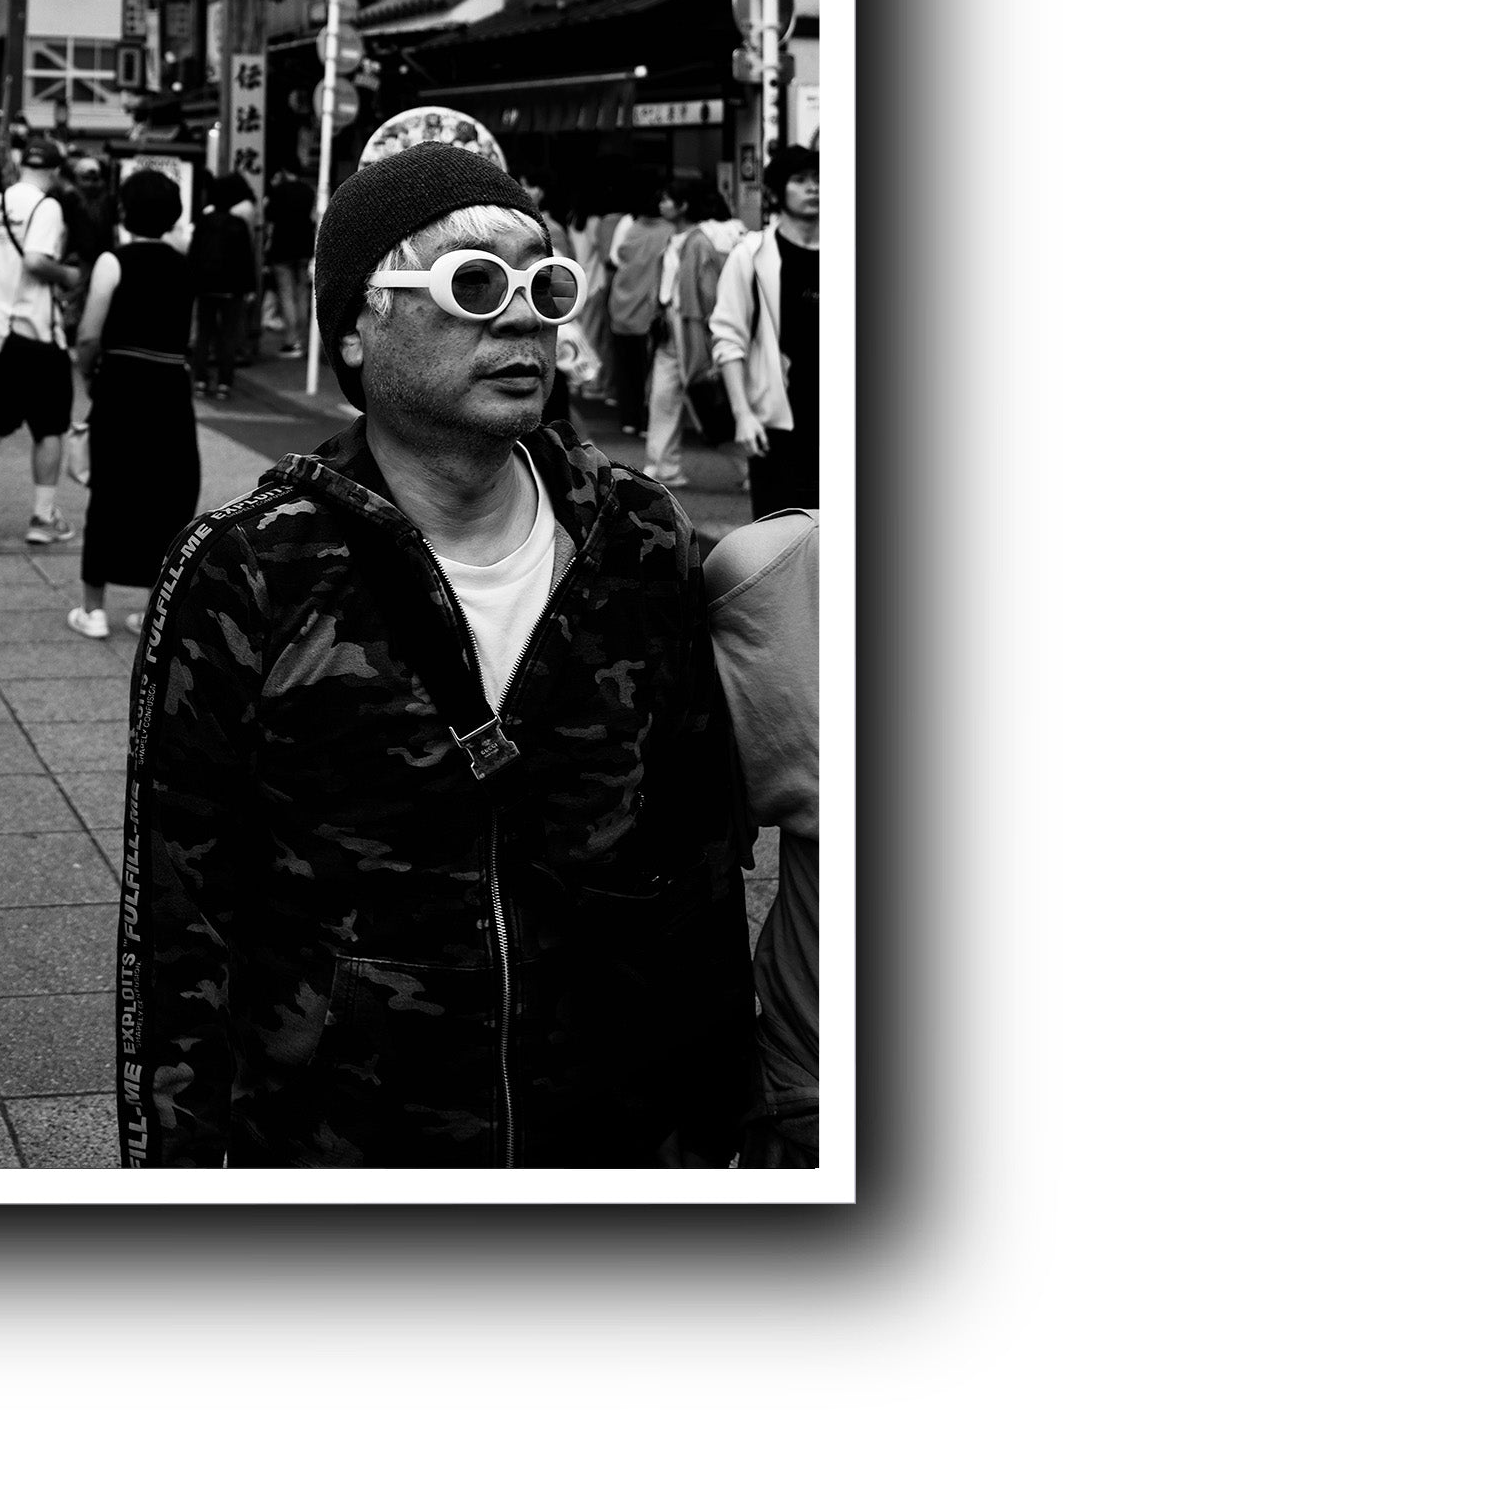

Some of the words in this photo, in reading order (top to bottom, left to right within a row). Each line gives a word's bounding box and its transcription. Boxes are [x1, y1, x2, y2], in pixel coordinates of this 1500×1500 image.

[235, 63, 262, 175] 伝法院
[145, 522, 214, 664] FULFILL-ME
[138, 728, 148, 765] SHAPELY
[123, 779, 141, 943] FULFILL-ME
[121, 952, 137, 1055] EXPLOITS
